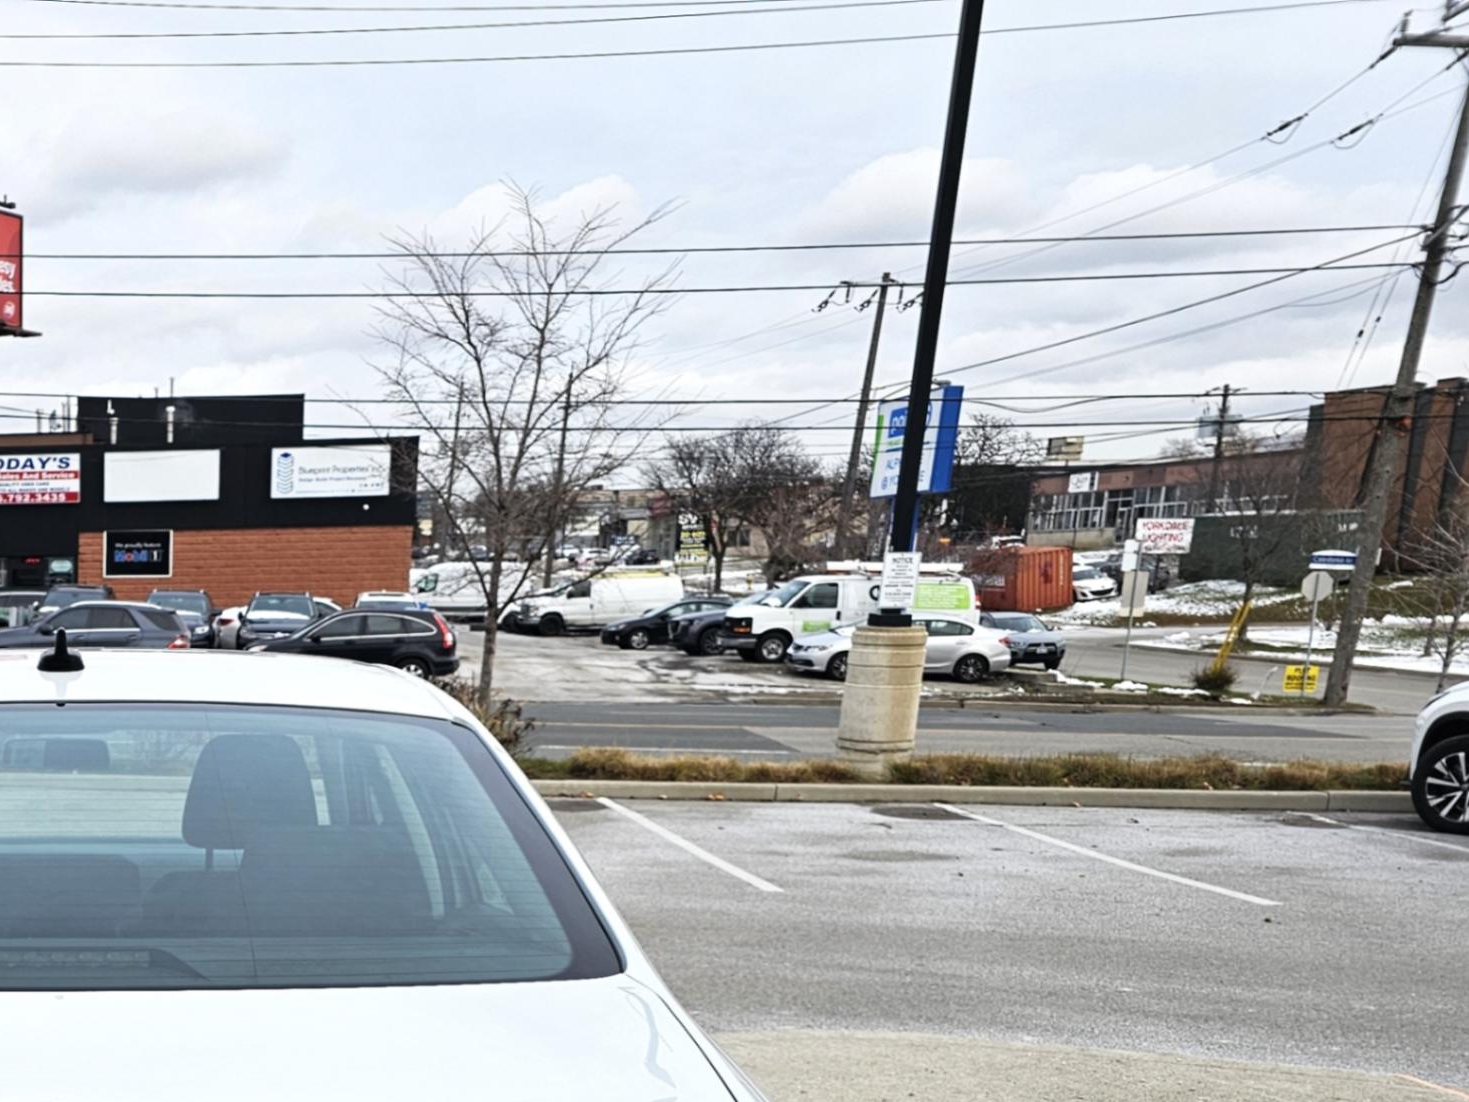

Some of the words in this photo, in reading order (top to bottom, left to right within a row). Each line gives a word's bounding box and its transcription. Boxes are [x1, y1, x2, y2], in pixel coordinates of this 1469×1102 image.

[298, 466, 330, 475] Blueprint
[332, 465, 369, 475] Properties
[22, 472, 40, 480] And
[41, 471, 75, 480] Service
[114, 549, 148, 562] Mobil
